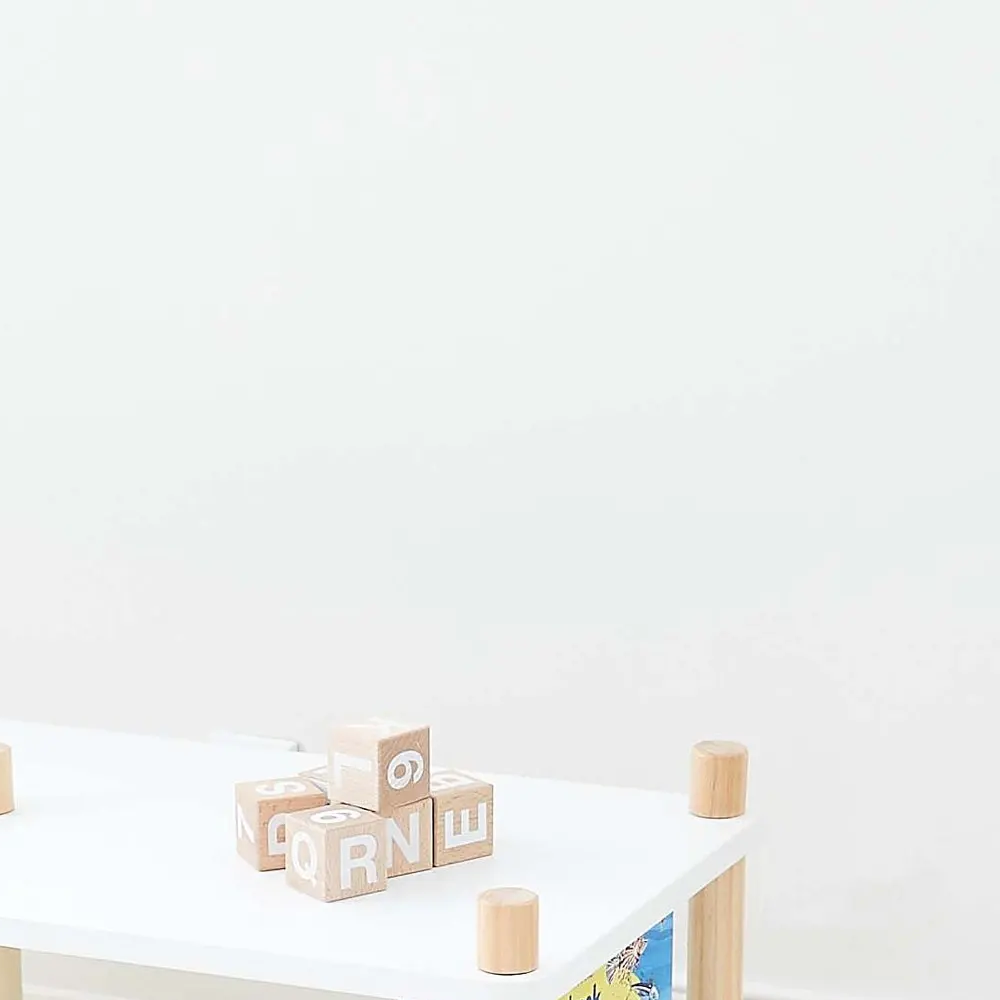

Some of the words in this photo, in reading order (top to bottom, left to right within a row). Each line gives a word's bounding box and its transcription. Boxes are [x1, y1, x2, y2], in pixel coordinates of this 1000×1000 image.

[384, 811, 420, 868] N
[444, 802, 487, 850] E
[291, 831, 319, 888] Q
[340, 834, 378, 890] R
